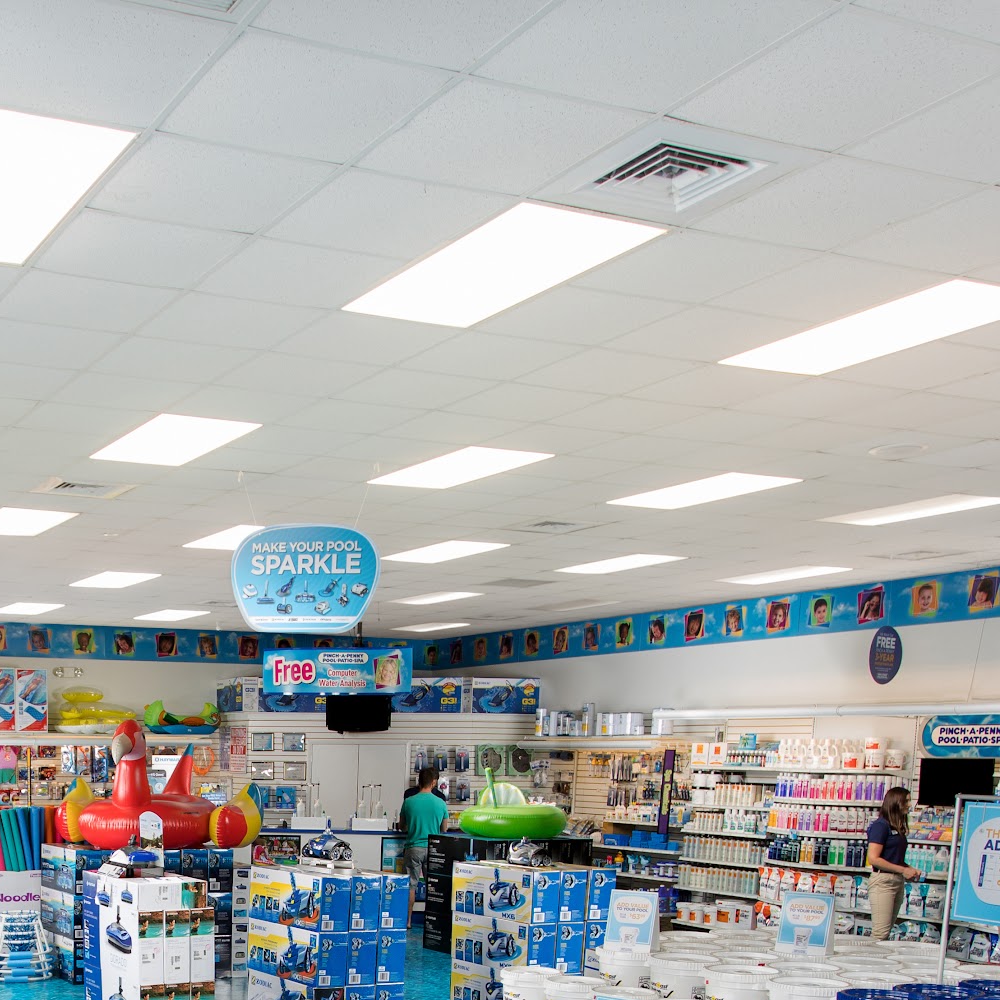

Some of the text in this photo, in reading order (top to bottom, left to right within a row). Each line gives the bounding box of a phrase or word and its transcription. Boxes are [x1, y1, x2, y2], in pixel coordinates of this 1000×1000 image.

[252, 540, 362, 553] MAKE YOUR POOL
[251, 553, 362, 575] SPARKLE
[876, 636, 897, 649] FREE
[273, 658, 314, 683] Free
[327, 669, 358, 678] Computer
[318, 678, 366, 688] Water Analysis
